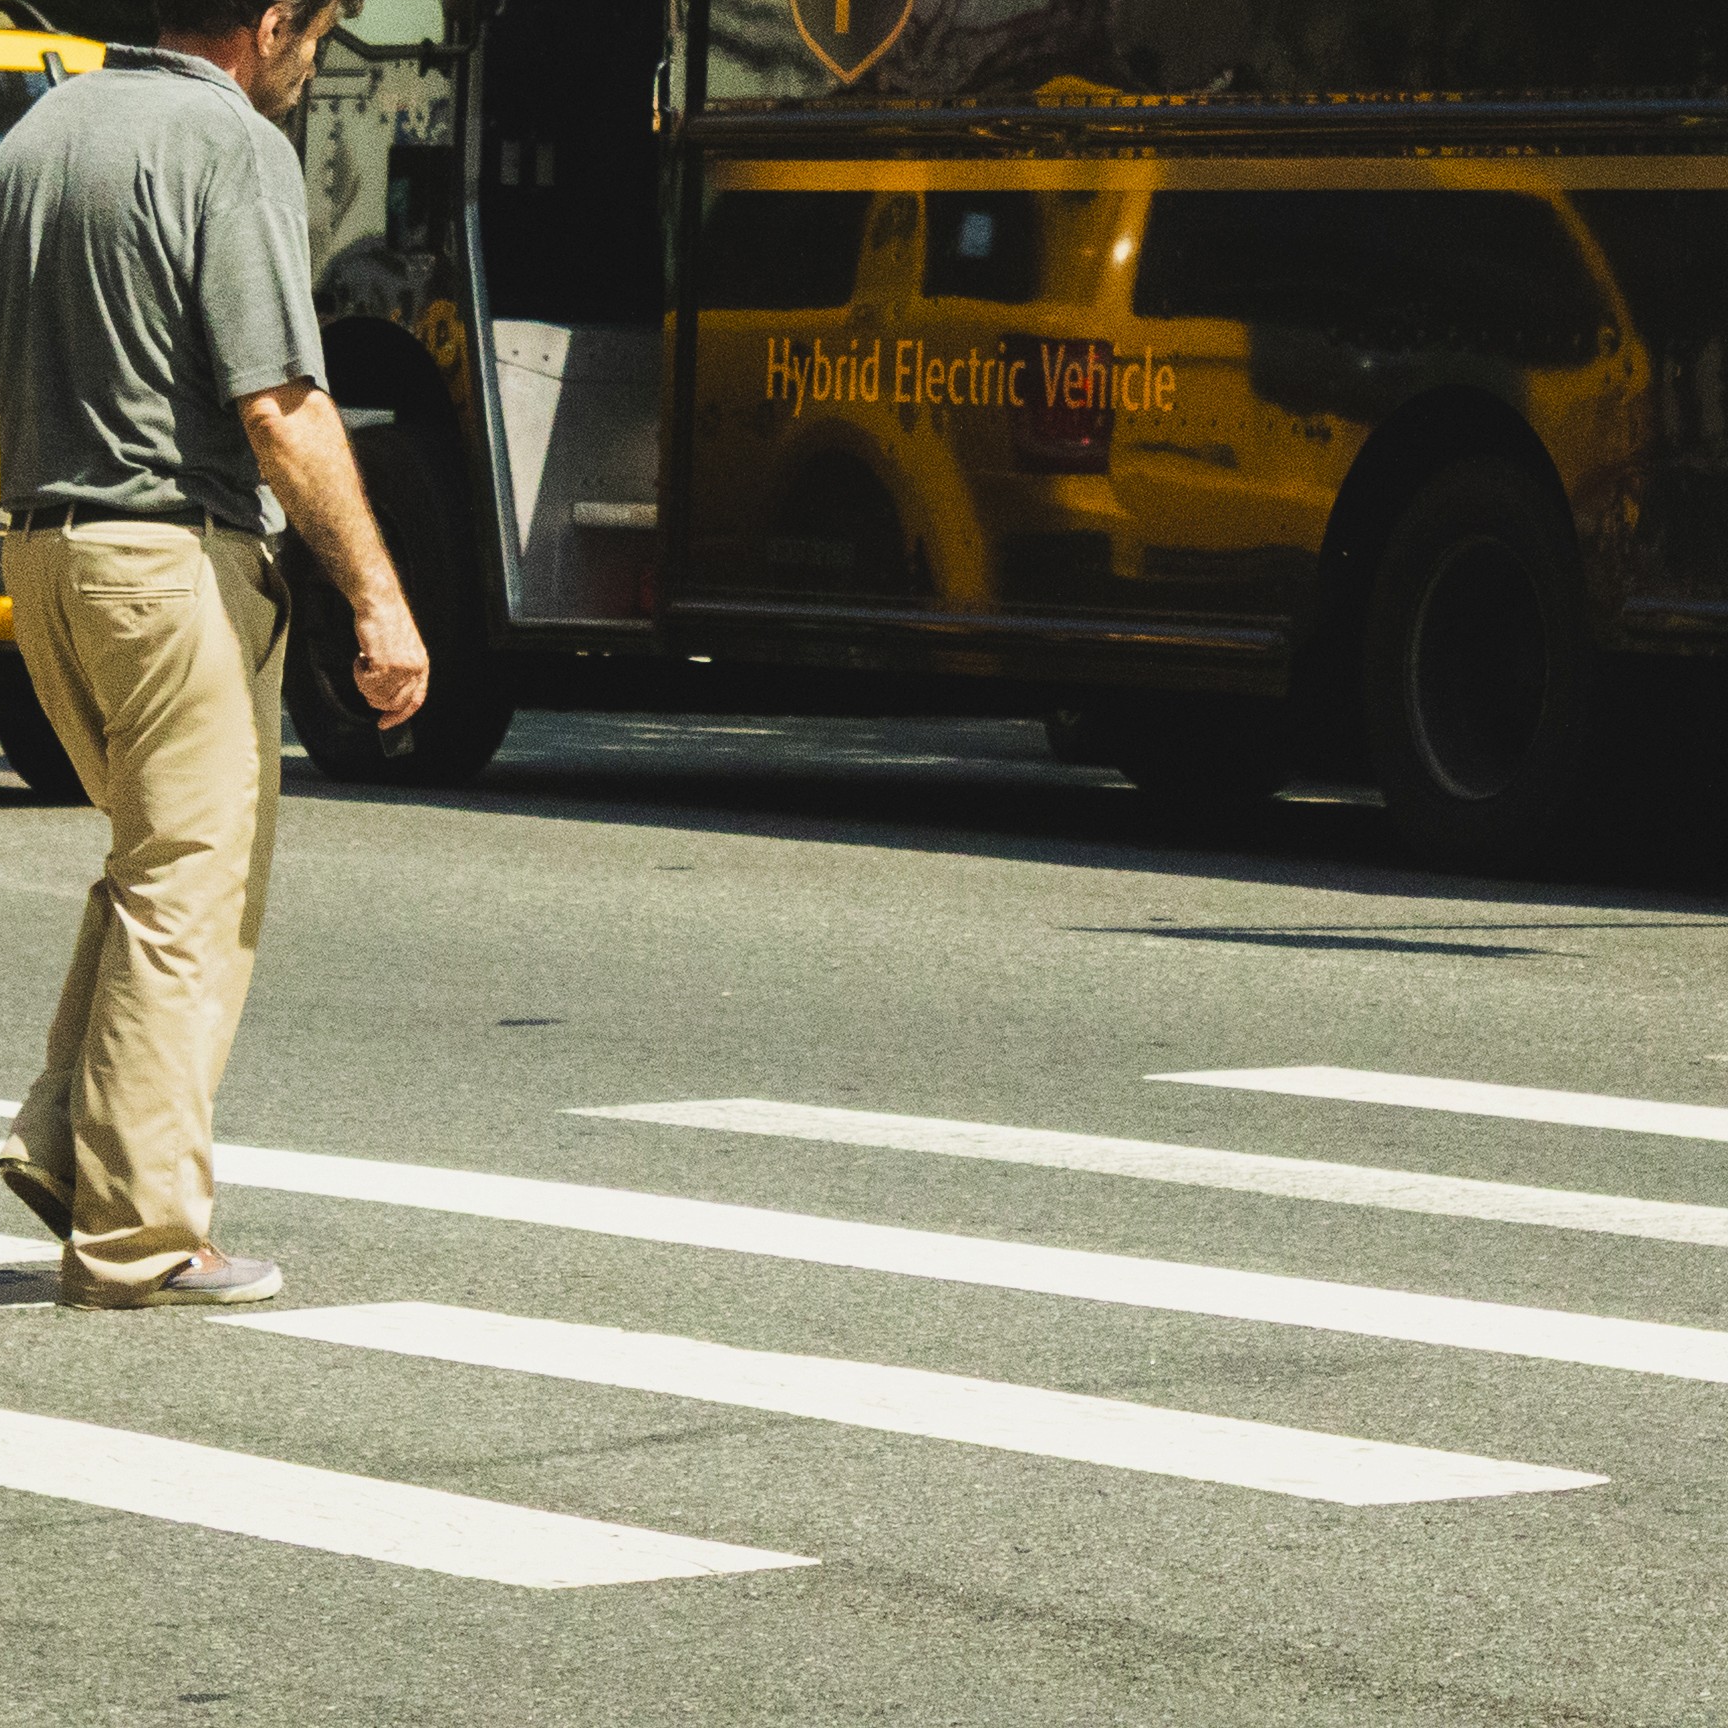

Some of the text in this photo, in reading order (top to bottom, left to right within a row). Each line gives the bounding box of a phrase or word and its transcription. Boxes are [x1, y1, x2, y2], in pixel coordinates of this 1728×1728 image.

[766, 337, 1178, 418] Hybrid Electric Vehicle
